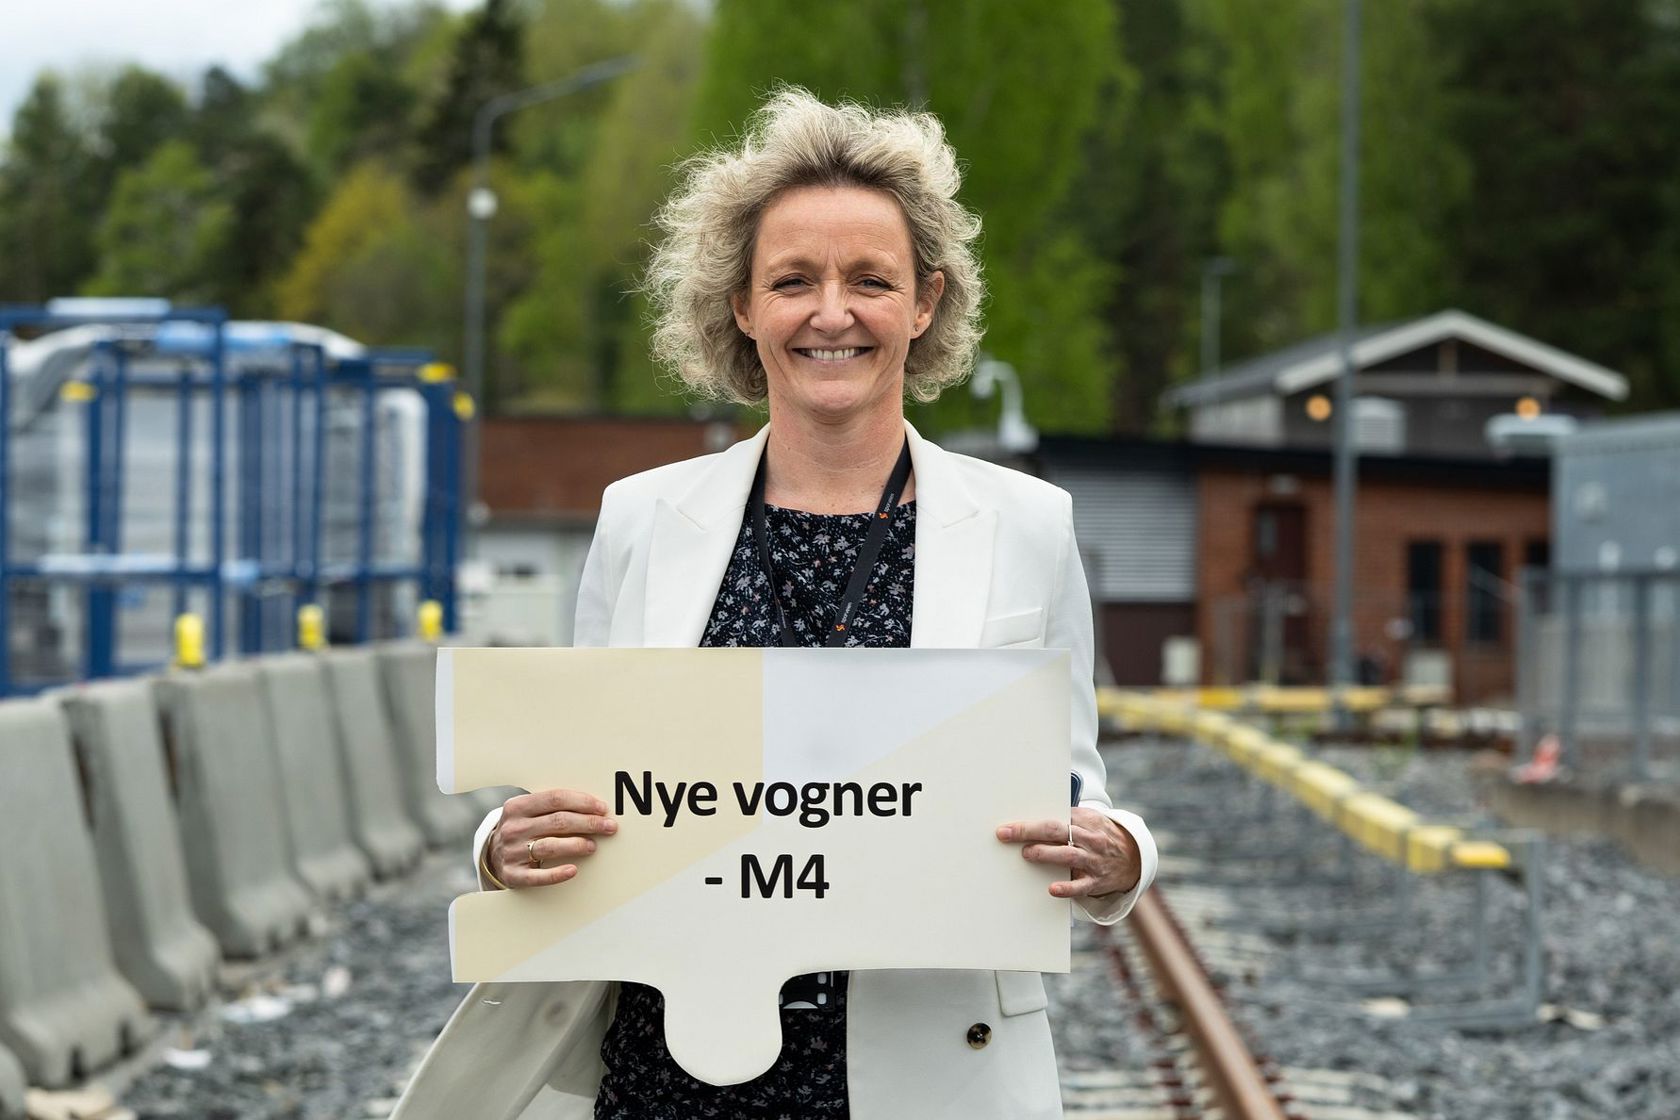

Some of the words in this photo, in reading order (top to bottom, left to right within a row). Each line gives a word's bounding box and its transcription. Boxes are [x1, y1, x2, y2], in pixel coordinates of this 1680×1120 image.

[614, 770, 719, 828] Nye
[732, 781, 923, 829] vogner
[740, 853, 831, 899] M4
